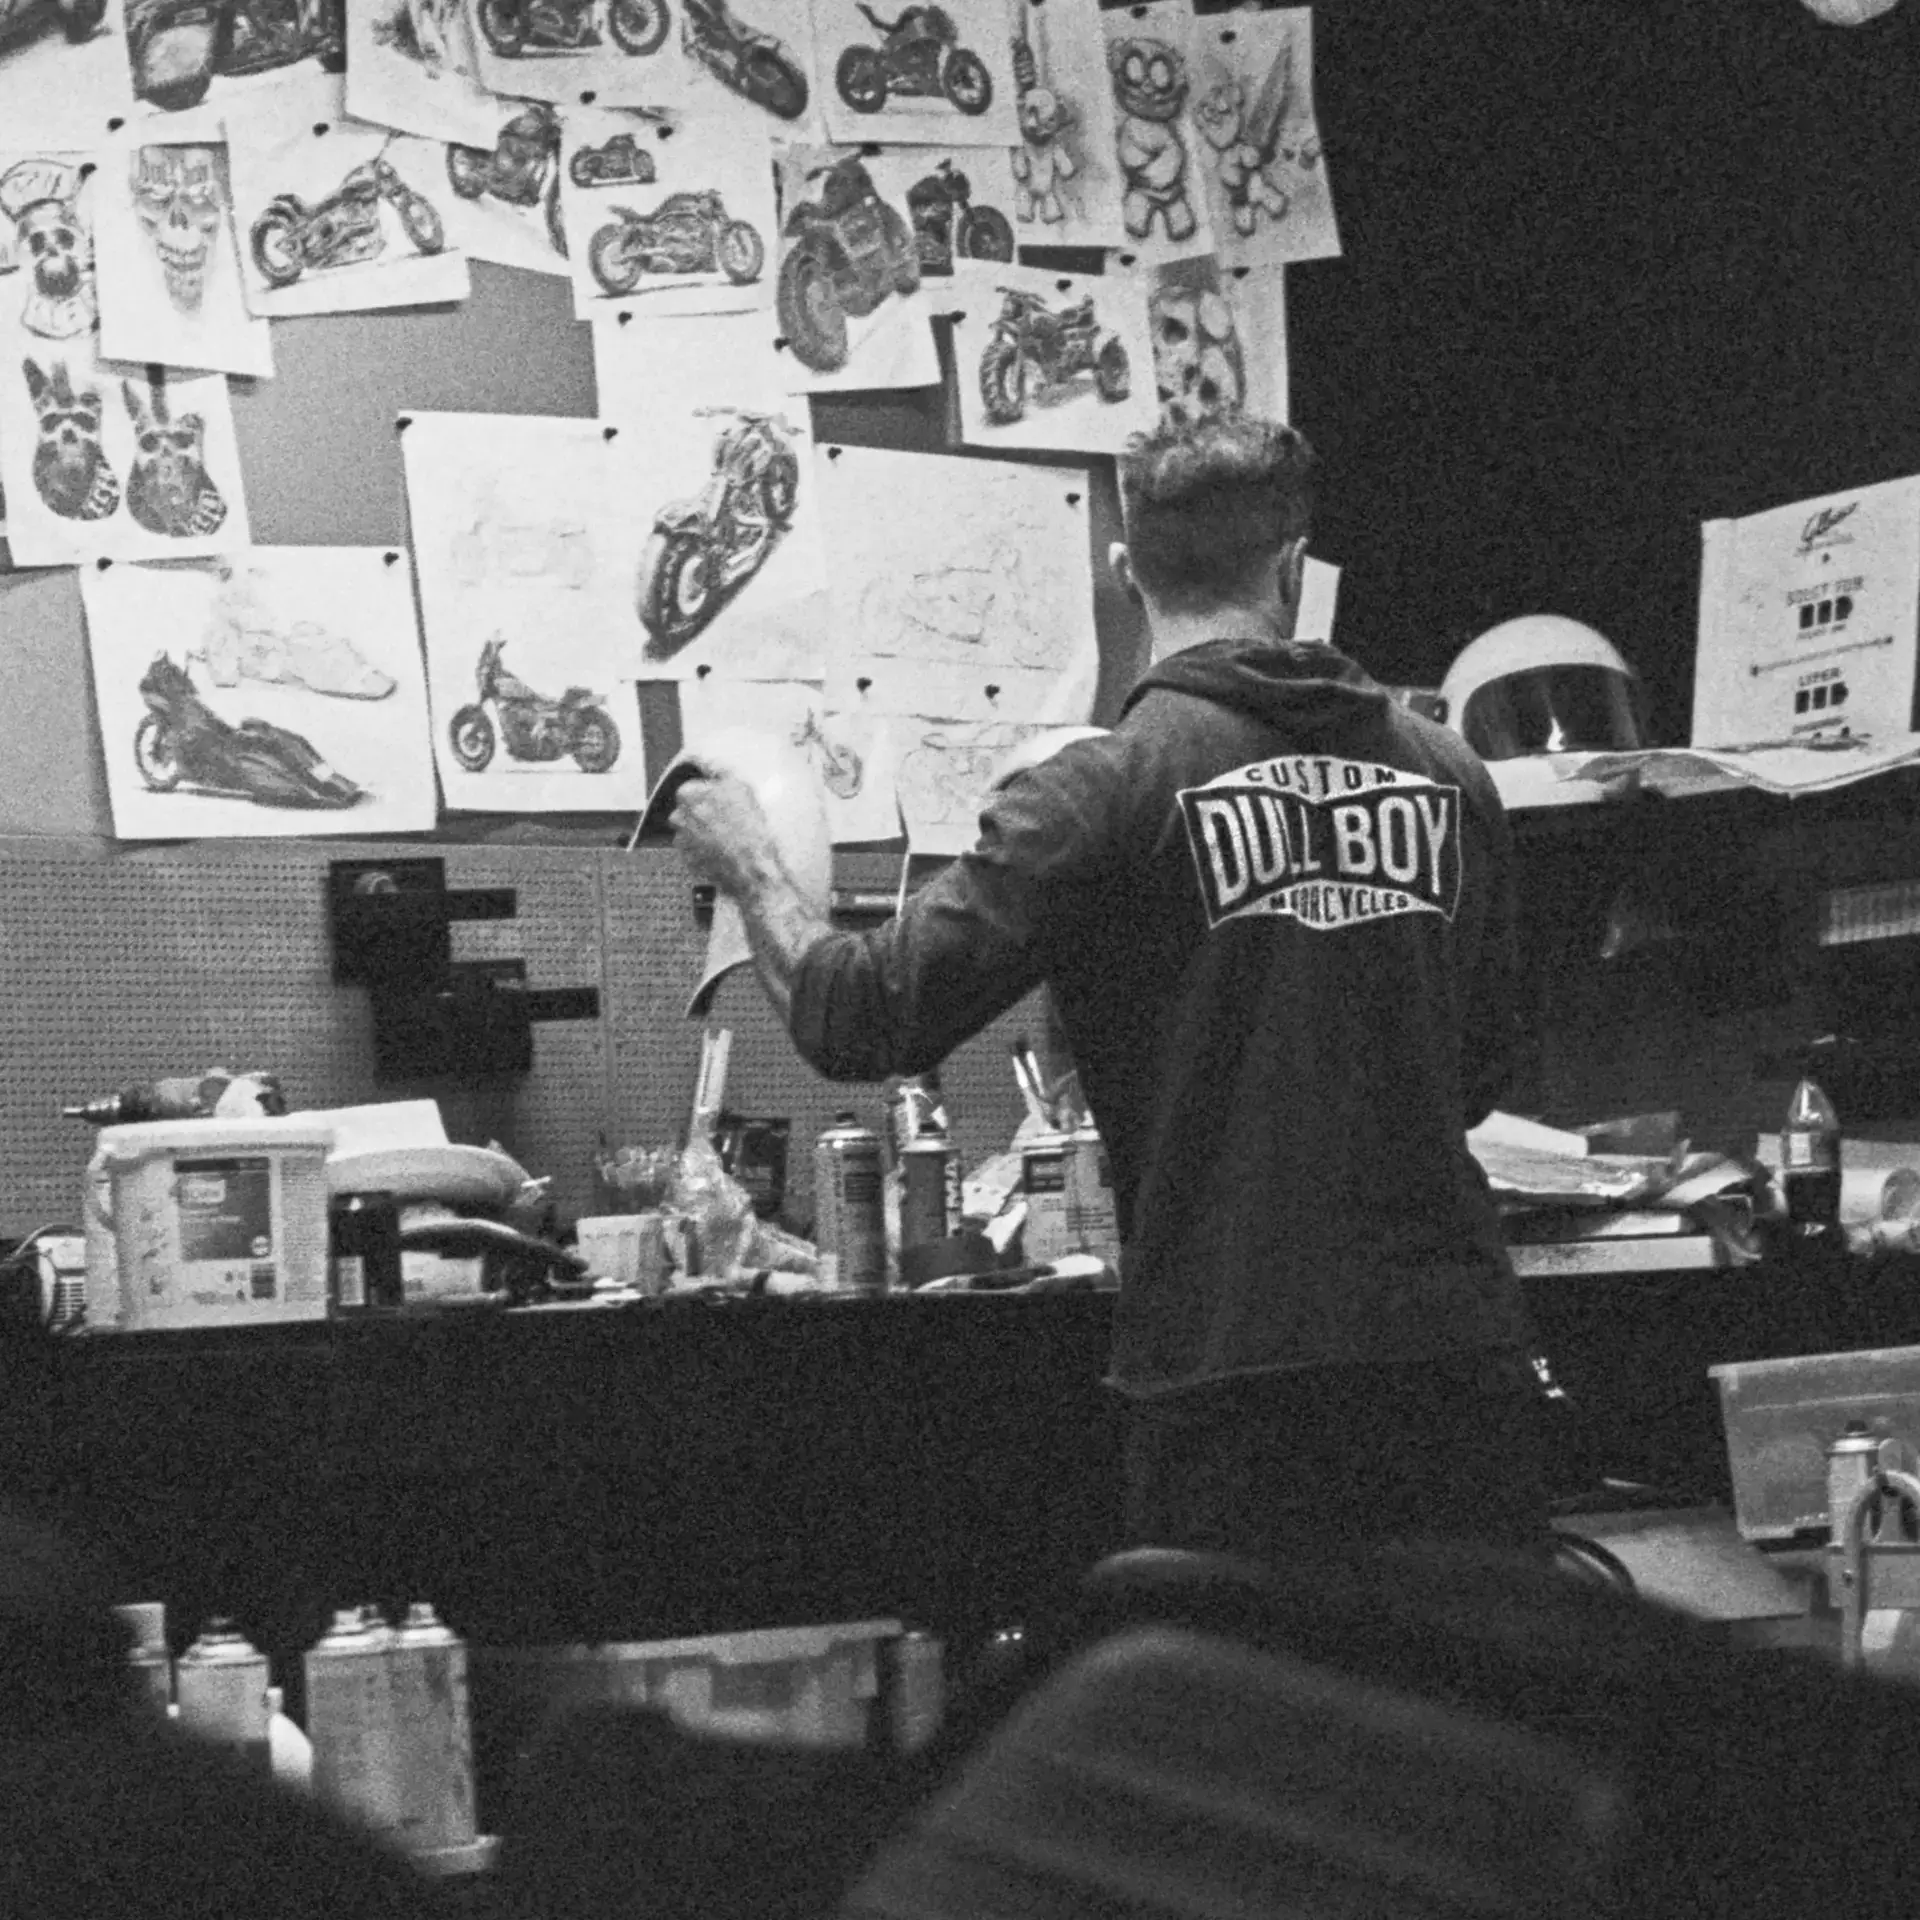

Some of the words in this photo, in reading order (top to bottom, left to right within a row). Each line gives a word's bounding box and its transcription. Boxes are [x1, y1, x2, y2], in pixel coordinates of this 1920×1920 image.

[1246, 759, 1397, 796] CUSTOM
[1195, 795, 1321, 907] DULL
[1333, 796, 1449, 896] BOY
[1269, 885, 1409, 923] MRCYCLES
